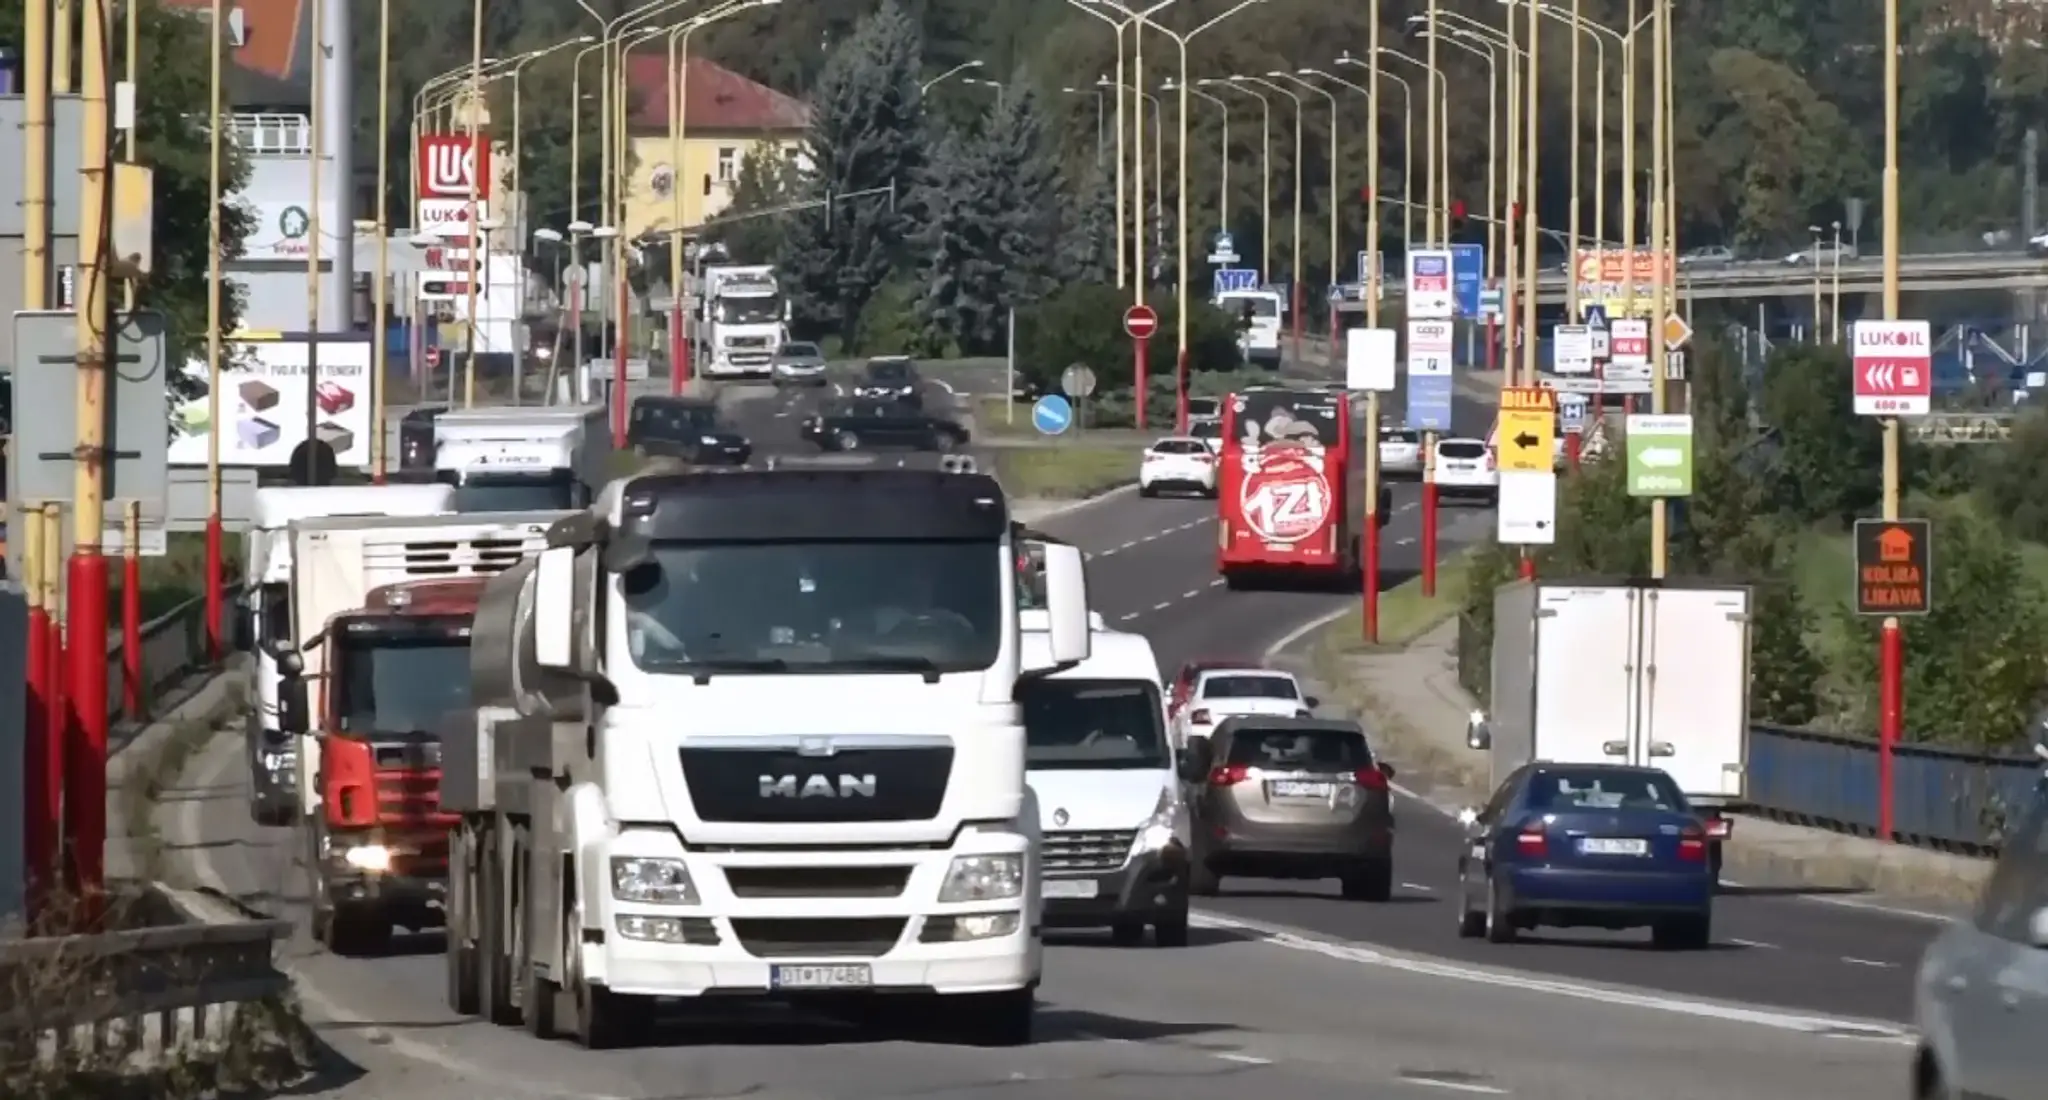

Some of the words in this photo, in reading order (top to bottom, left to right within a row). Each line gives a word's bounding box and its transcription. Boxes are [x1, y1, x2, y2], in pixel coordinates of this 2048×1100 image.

[1860, 332, 1924, 346] LUKOIL
[1501, 391, 1552, 408] BILLA
[759, 774, 876, 797] MAN
